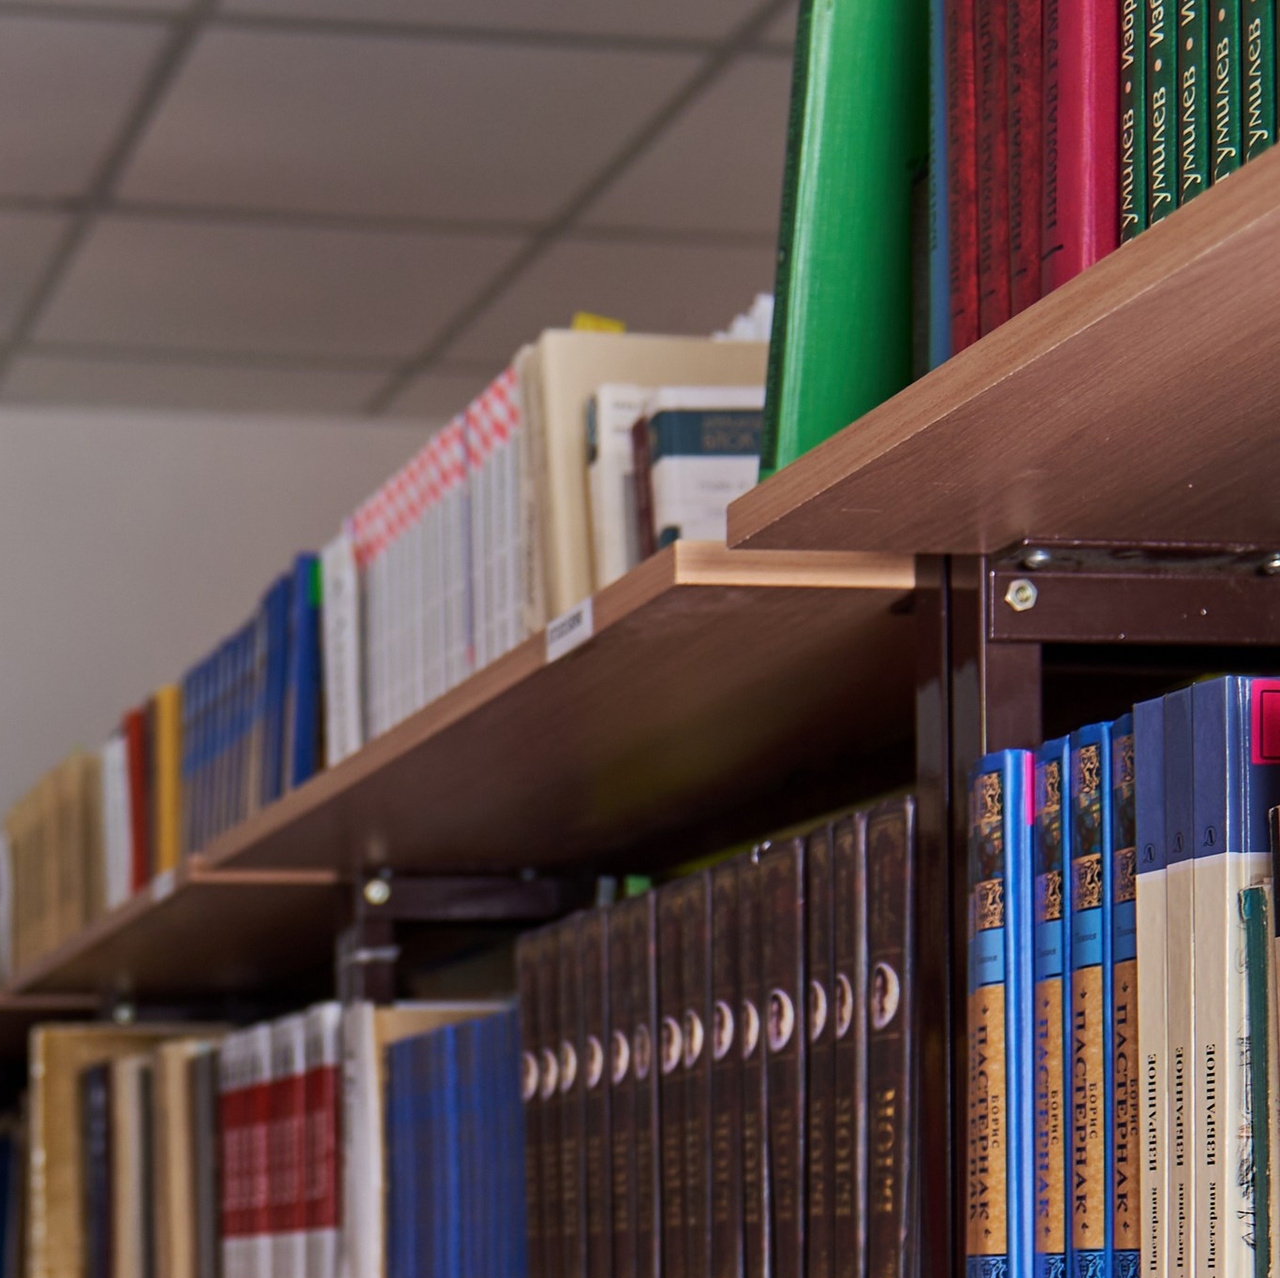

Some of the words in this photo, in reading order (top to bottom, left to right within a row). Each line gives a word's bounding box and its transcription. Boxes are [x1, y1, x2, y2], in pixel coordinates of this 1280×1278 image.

[1214, 36, 1236, 185] Гумилев
[977, 1025, 990, 1221] ПАСТЕРНАК
[990, 1094, 1000, 1150] БОРИС
[1037, 1017, 1050, 1219] ПАСТЕРНАК
[1050, 1089, 1059, 1146] БОРИС
[1074, 1010, 1087, 1215] ПАСТЕРНАК
[1088, 1082, 1098, 1141] БОРИС
[1116, 1004, 1129, 1212] ПАСТЕРНАК
[1129, 1078, 1138, 1138] БОРИС
[1147, 1053, 1158, 1172] ИЗБРАННОЕ
[1175, 1046, 1184, 1167] ИЗБРАННОЕ
[1206, 1043, 1216, 1166] ИЗБРАННОЕ
[1150, 1187, 1159, 1271] Пастернак
[1177, 1182, 1186, 1268] Пастернак
[1207, 1181, 1218, 1269] Пастернак
